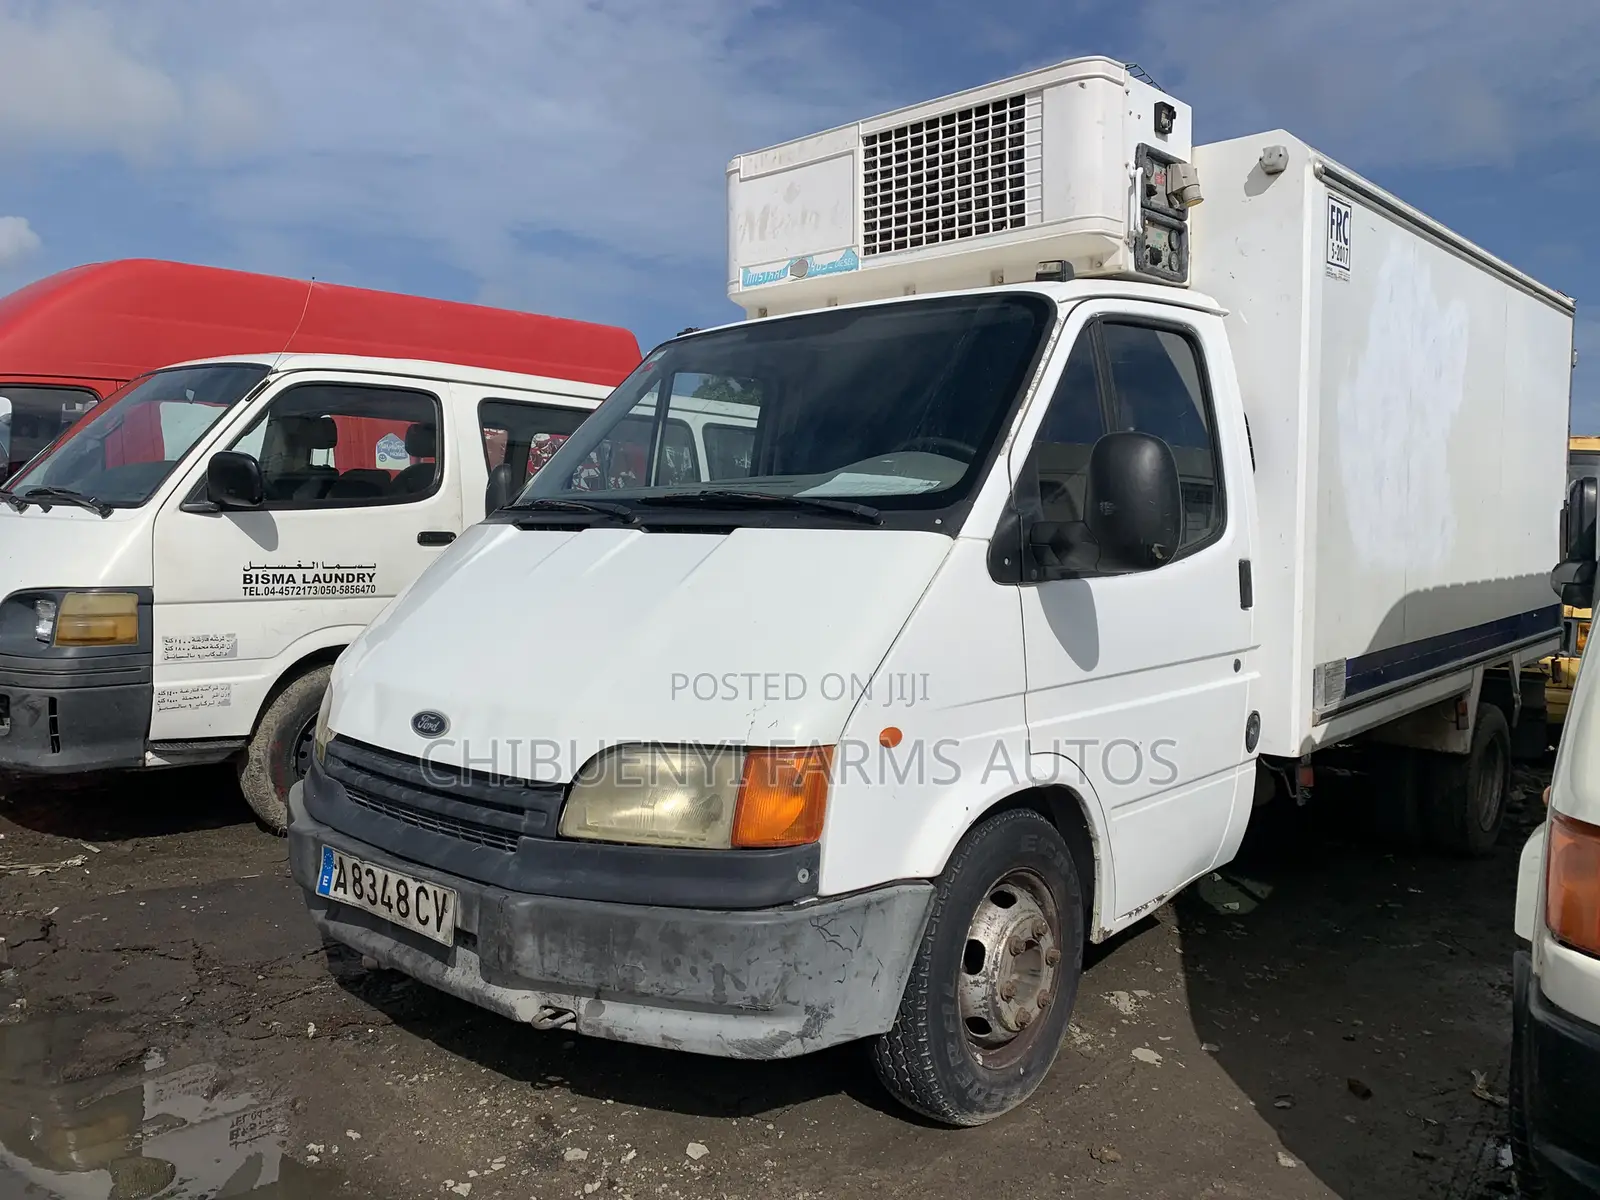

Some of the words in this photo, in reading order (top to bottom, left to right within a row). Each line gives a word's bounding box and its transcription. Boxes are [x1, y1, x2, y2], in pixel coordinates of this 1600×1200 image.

[1330, 204, 1350, 246] FRC
[242, 573, 297, 585] BISMA
[302, 572, 377, 584] LAUNDRY
[417, 714, 441, 732] Ford
[322, 875, 330, 887] E
[333, 856, 448, 933] A8348CV
